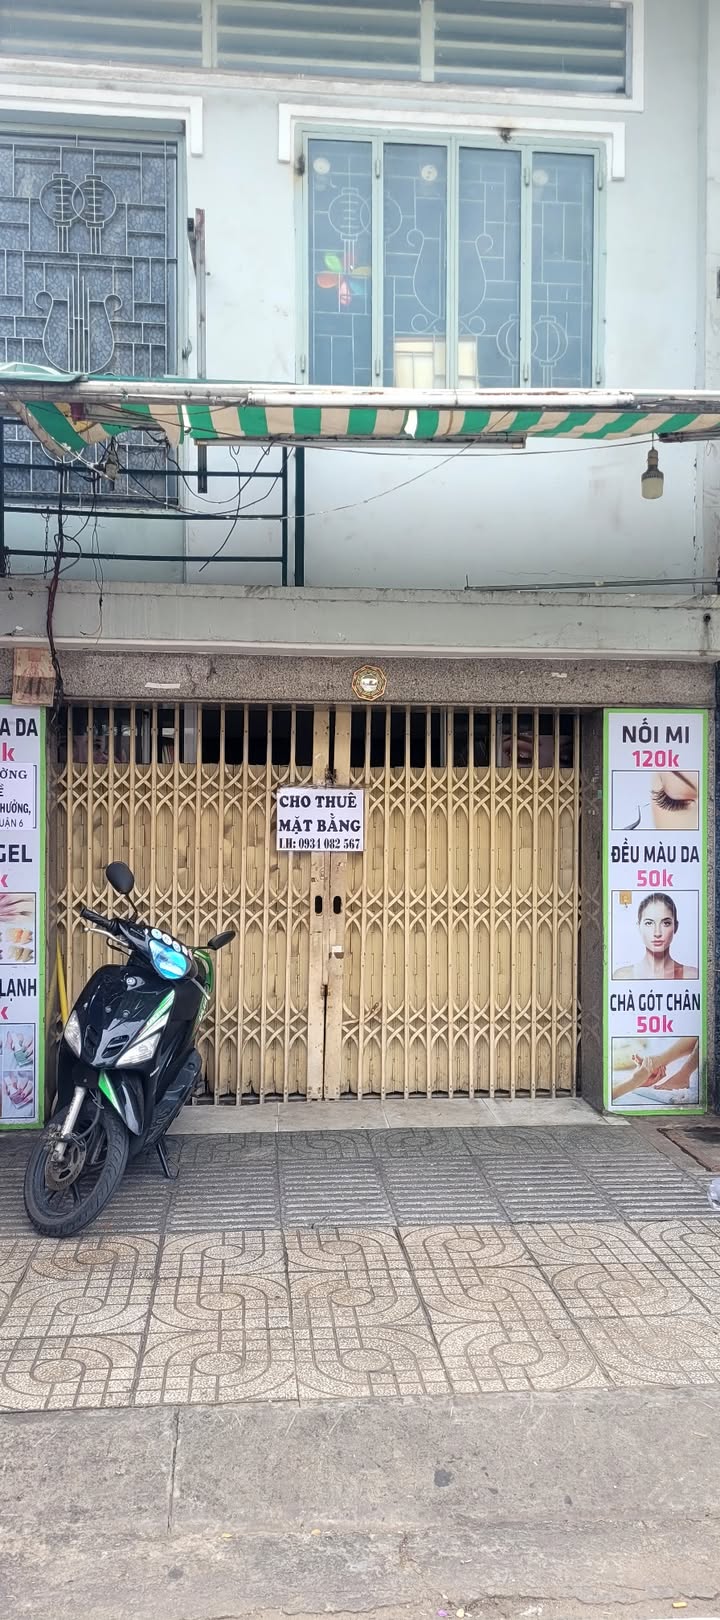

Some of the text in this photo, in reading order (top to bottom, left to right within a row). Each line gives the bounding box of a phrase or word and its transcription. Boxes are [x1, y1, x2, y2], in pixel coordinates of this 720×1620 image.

[15, 717, 39, 737] DA
[622, 717, 690, 744] NỐI MI
[632, 749, 680, 768] 120k
[279, 791, 358, 809] CHO THUÊ
[18, 818, 24, 828] 6
[278, 812, 361, 835] MẶT BẰNG
[279, 837, 296, 849] LH:
[323, 837, 341, 850] 082
[343, 837, 361, 850] 567
[611, 837, 700, 863] ĐỀU MÀU DA
[0, 844, 33, 863] GEL
[636, 868, 674, 887] 50k
[610, 988, 701, 1011] CHÀ GÓT CHÂN
[636, 1014, 674, 1034] 50k
